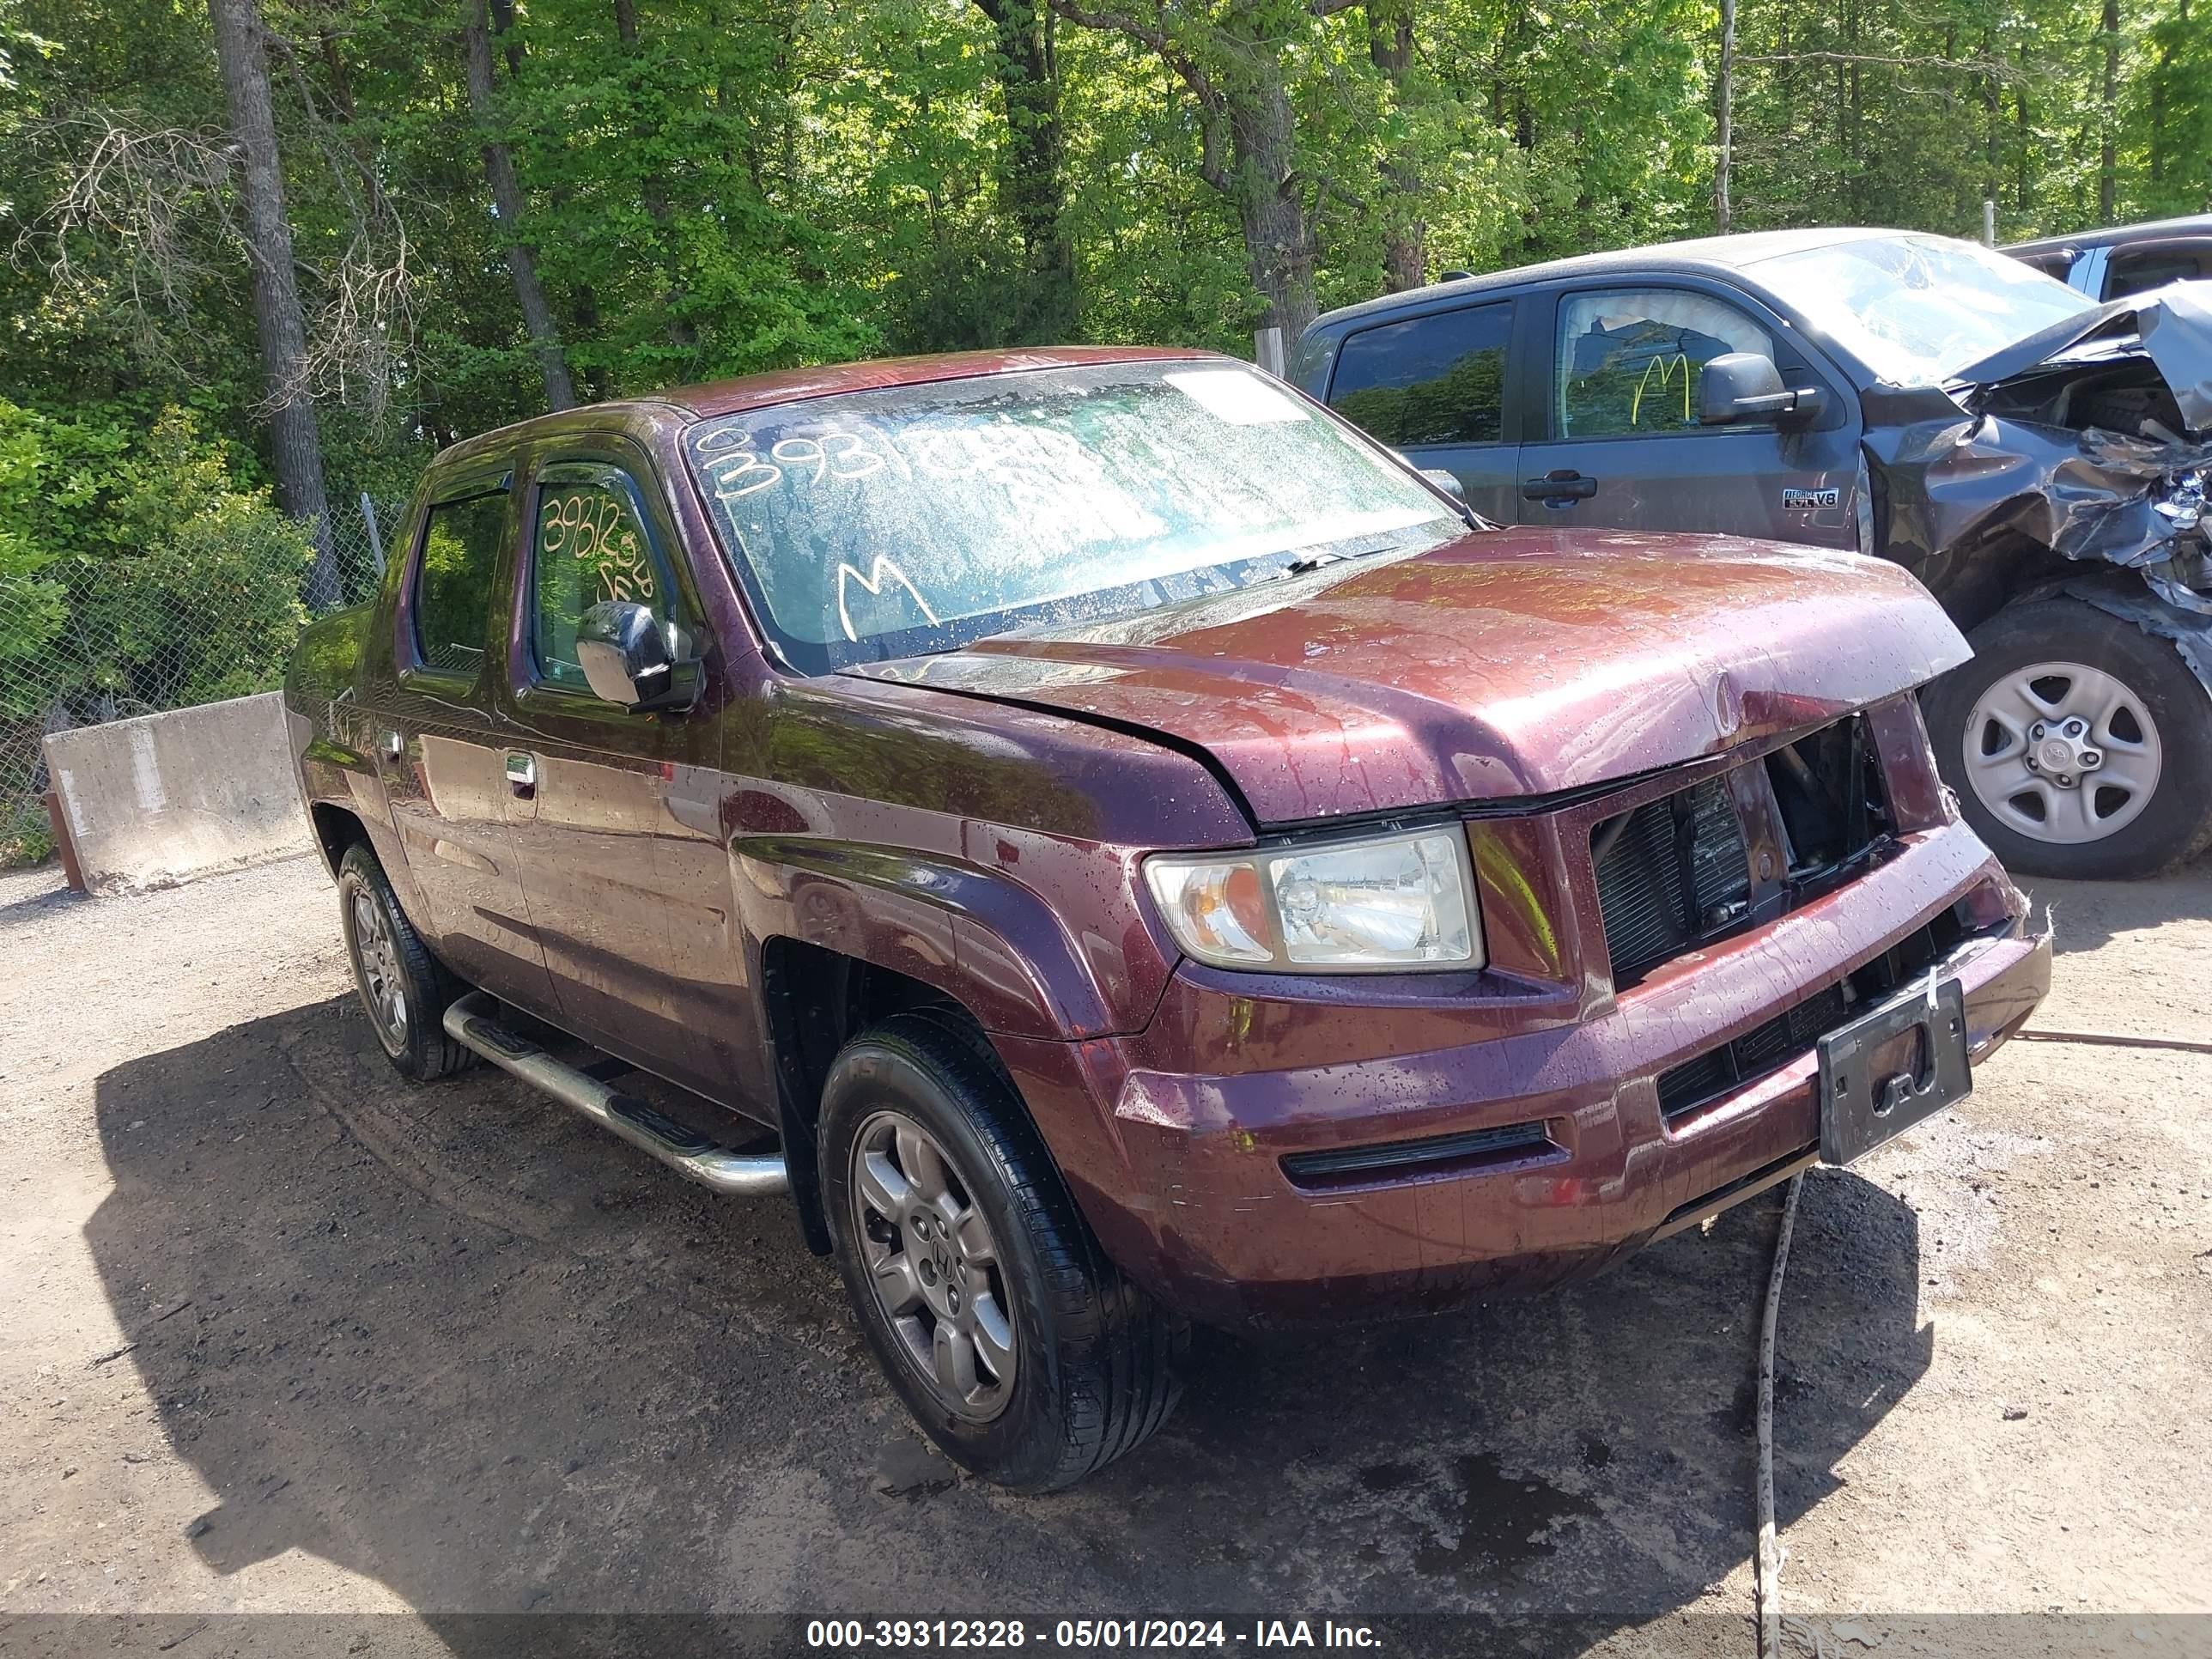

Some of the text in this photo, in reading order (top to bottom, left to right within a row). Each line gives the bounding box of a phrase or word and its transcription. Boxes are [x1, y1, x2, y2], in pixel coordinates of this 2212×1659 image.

[1632, 353, 1691, 425] M
[1816, 492, 1837, 506] V8
[838, 556, 941, 643] M
